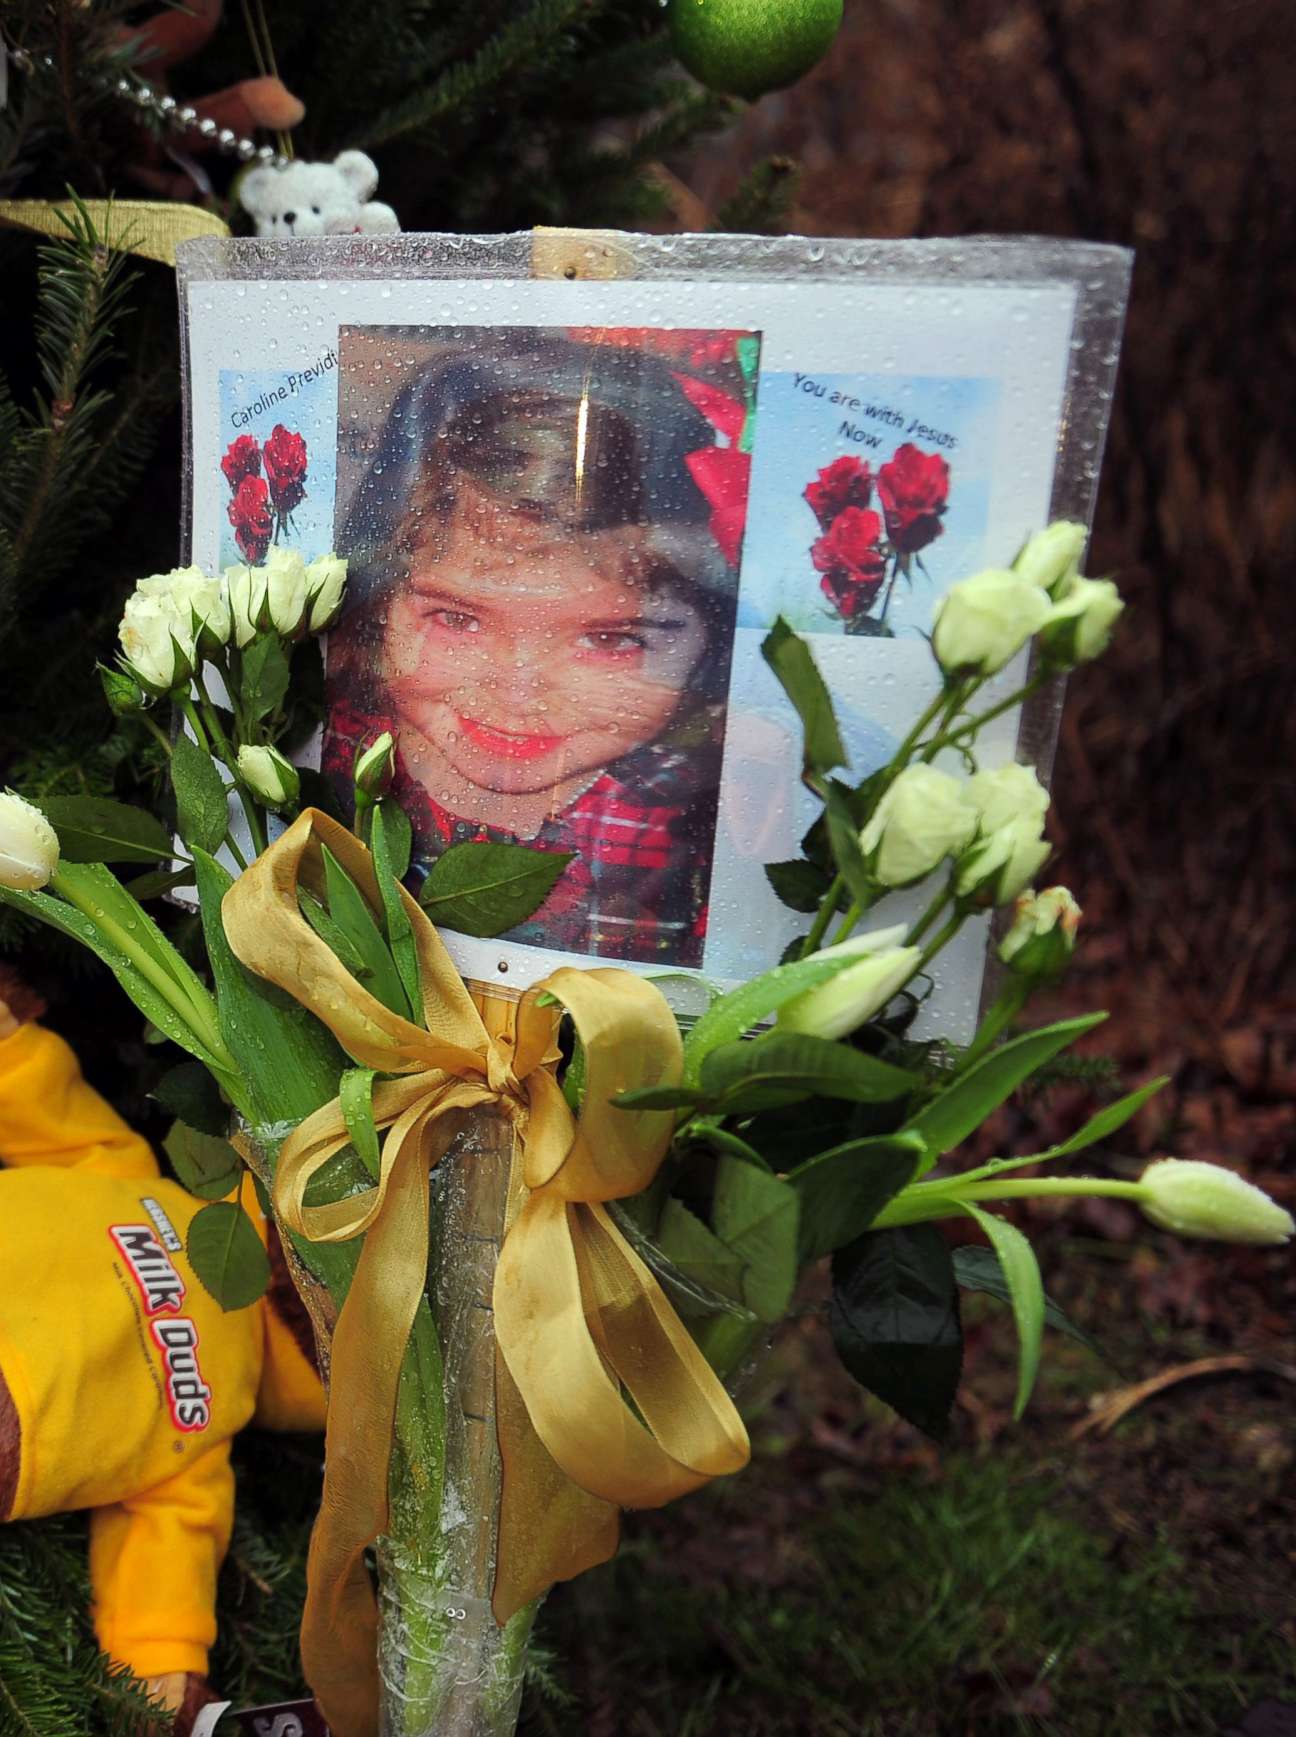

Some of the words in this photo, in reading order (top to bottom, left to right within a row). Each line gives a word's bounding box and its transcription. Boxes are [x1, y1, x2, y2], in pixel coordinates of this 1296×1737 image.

[231, 386, 288, 429] Caroline
[792, 372, 826, 398] You
[828, 390, 861, 413] are
[863, 403, 904, 428] with
[906, 418, 959, 449] Jesus
[838, 420, 883, 449] Now
[117, 1229, 183, 1312] Milk
[159, 1326, 208, 1427] Duds
